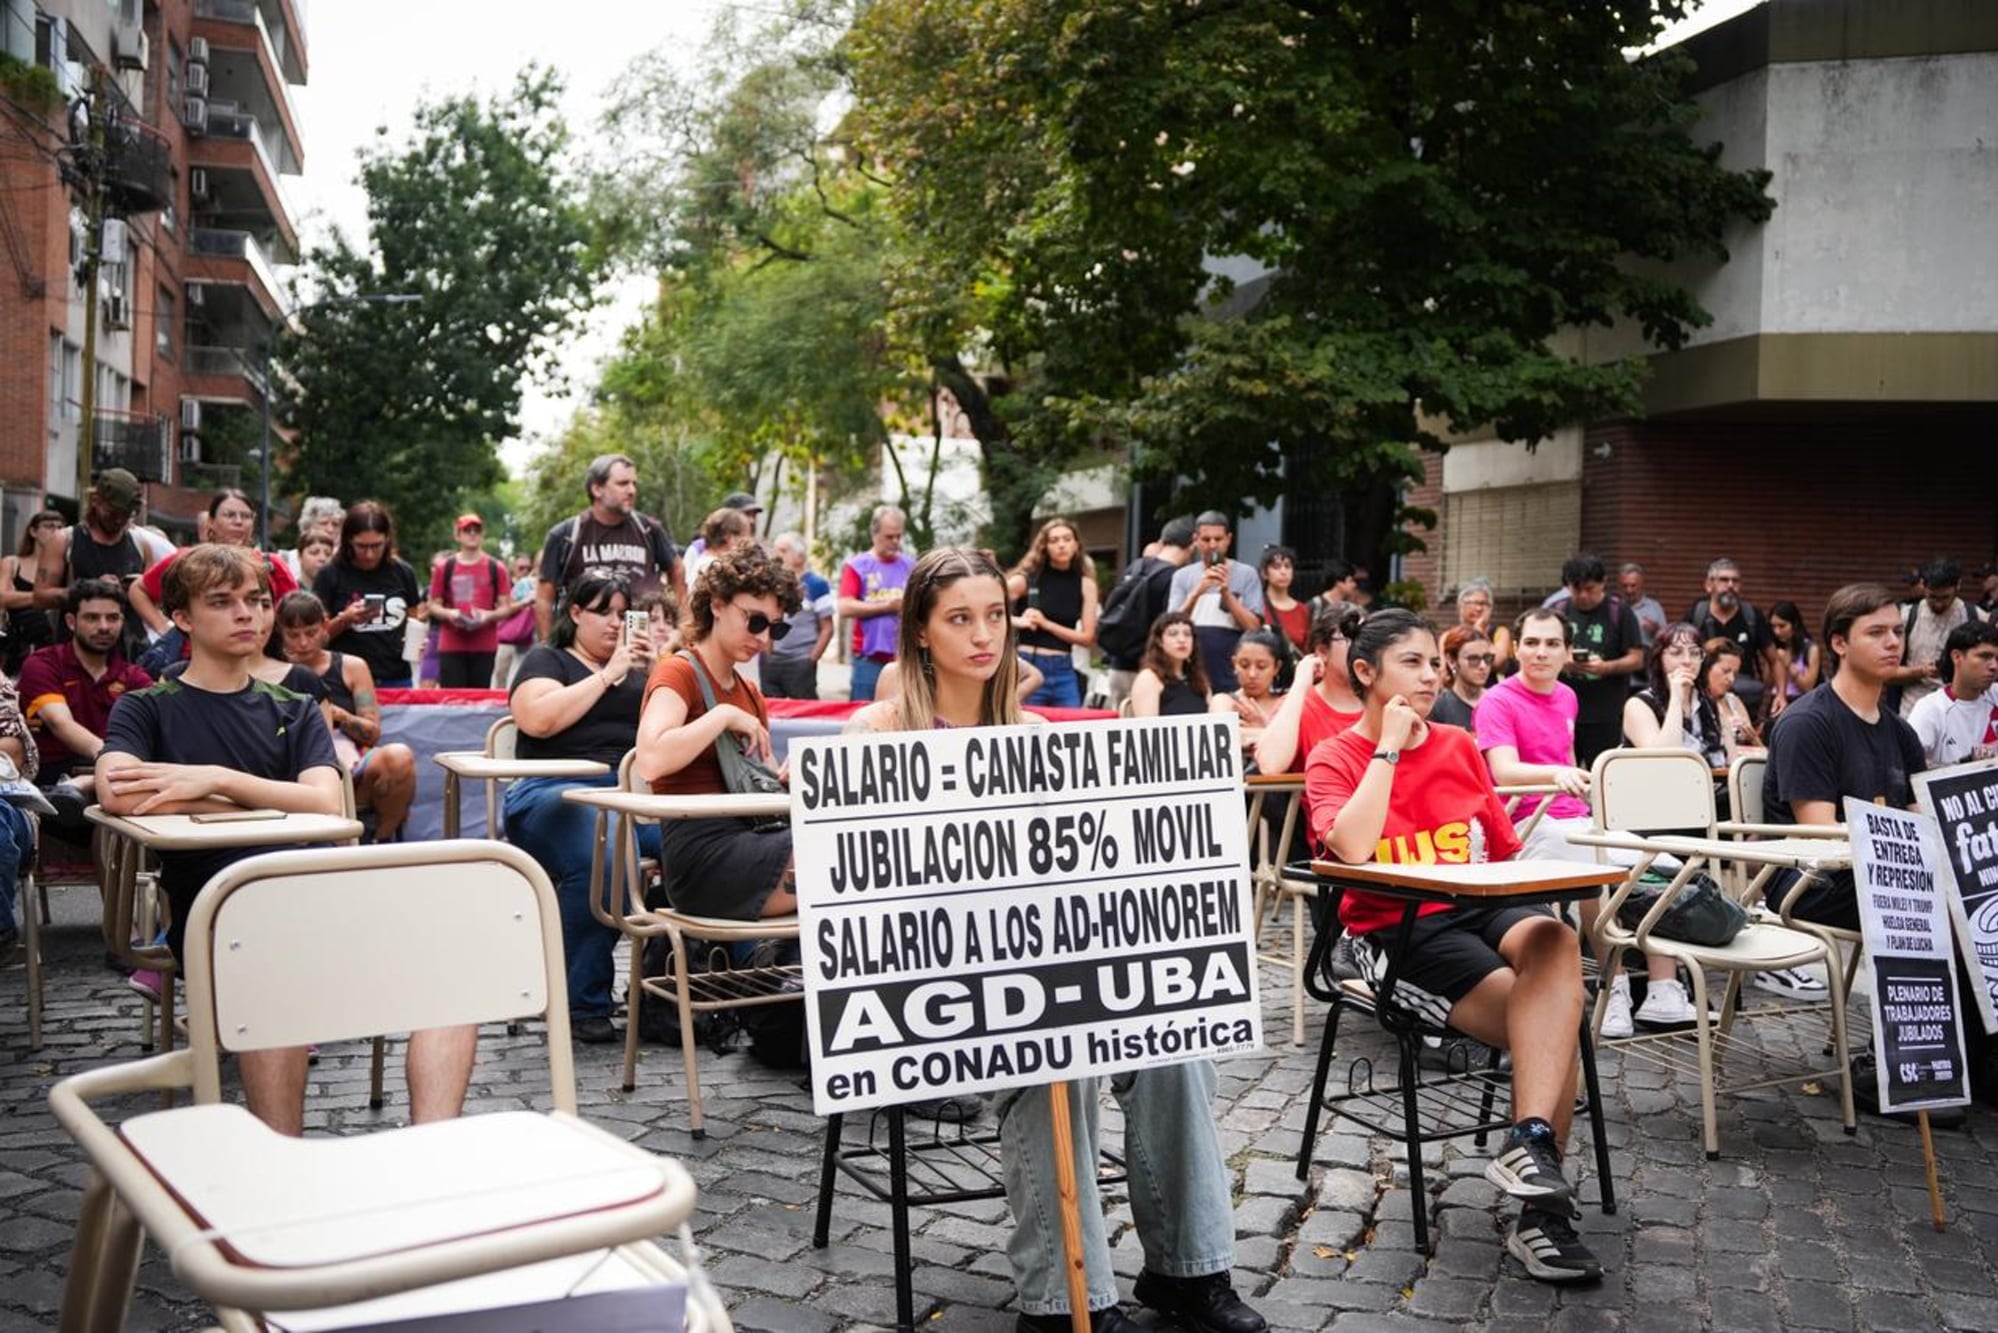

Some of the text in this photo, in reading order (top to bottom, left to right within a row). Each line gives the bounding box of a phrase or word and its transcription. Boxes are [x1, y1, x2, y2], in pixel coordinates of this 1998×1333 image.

[800, 722, 1234, 810] SALARIO = CANASTA FAMILIAR
[1941, 795, 1965, 822] NO
[1964, 790, 1985, 816] AL
[1866, 813, 1920, 842] BASTA DE
[829, 803, 1223, 894] JUBILACION 85% MOVIL
[1872, 839, 1925, 869] ENTREGA
[1956, 821, 1998, 874] fat
[1867, 863, 1934, 893] Y REPRESION
[817, 878, 1241, 981] SALARIO A LOS AD-HONOREM
[1887, 985, 1944, 1001] PLENARIO DE
[1884, 1004, 1952, 1022] TRABAJADORES
[1898, 1024, 1944, 1041] JUBILADOS
[825, 1018, 1254, 1100] en CONADU histórica
